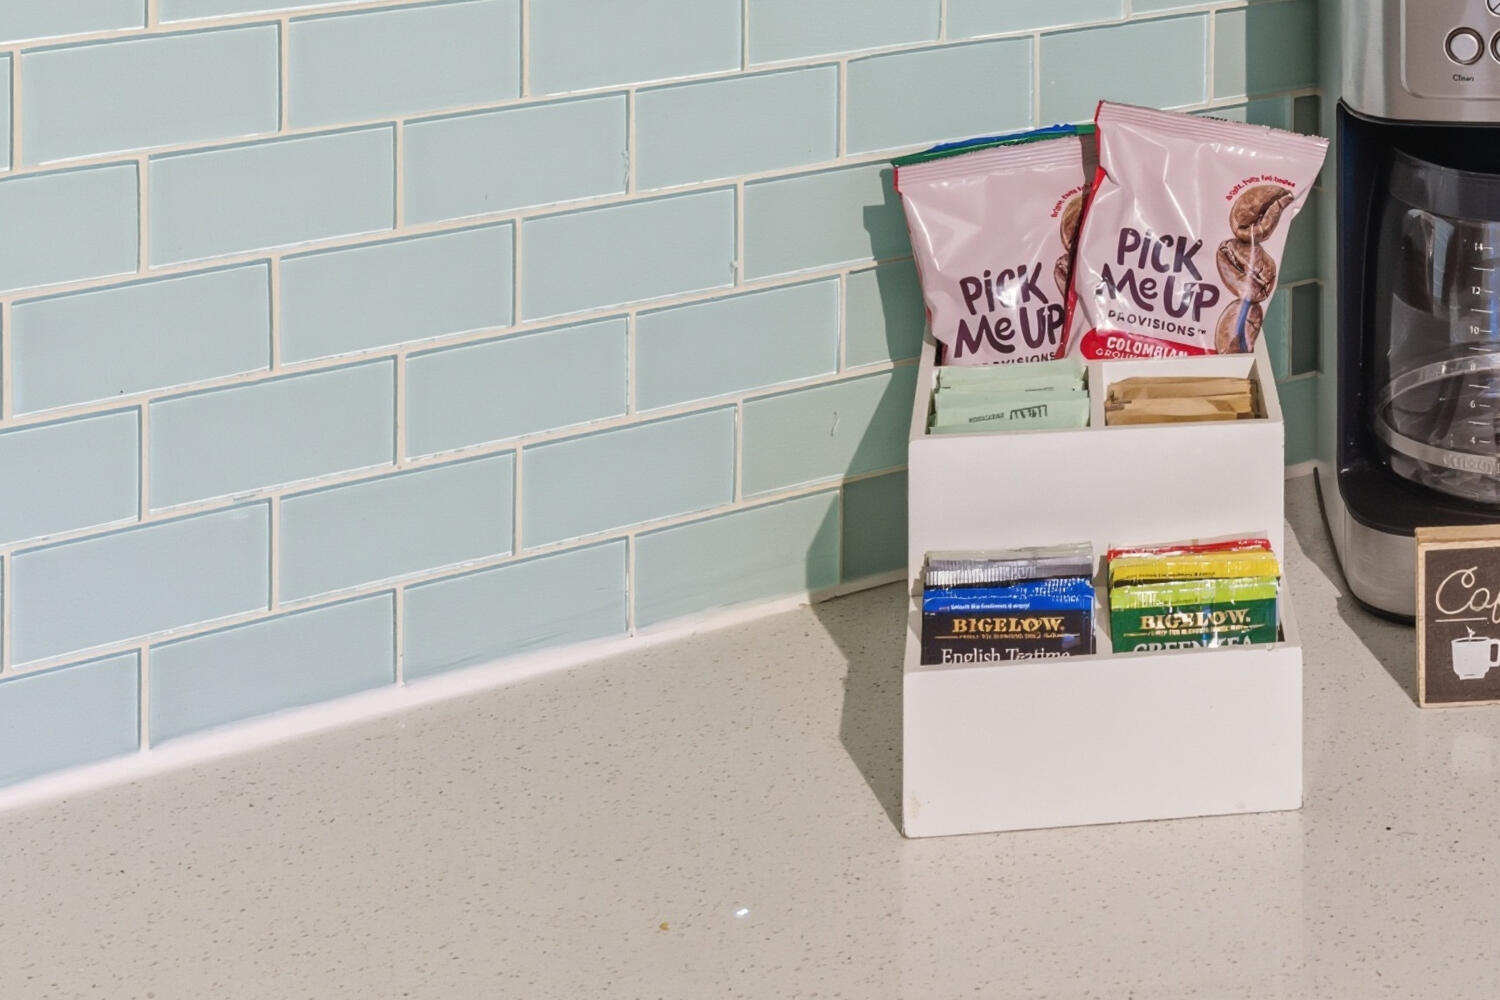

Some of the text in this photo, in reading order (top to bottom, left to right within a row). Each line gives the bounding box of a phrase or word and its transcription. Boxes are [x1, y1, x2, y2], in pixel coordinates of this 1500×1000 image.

[1095, 262, 1220, 323] Me UP
[1471, 286, 1481, 295] 12
[954, 303, 1066, 358] Me UP
[1469, 325, 1480, 335] 10
[952, 616, 1065, 633] BIGELOW
[1140, 608, 1250, 630] BIGELOW
[941, 647, 1001, 665] English
